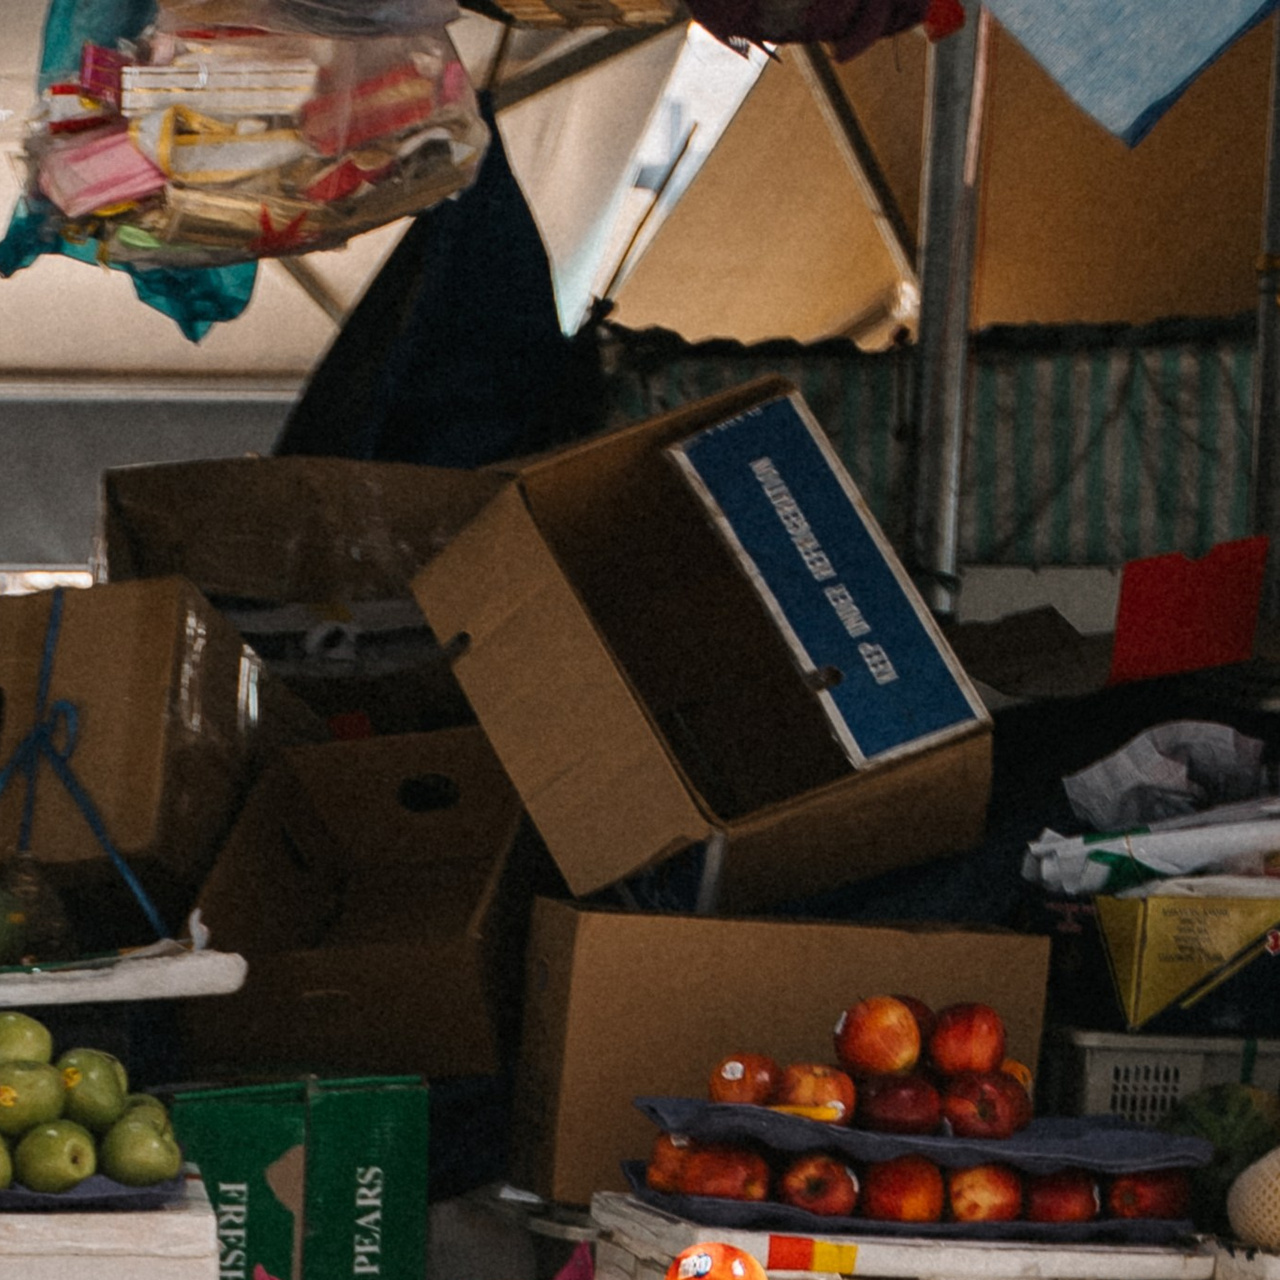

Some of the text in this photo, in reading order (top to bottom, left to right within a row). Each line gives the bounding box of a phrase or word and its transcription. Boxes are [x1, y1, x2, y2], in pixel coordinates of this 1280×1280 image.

[749, 456, 900, 685] KEEP UNDER REFRIGERATION
[353, 1166, 383, 1274] PEARS
